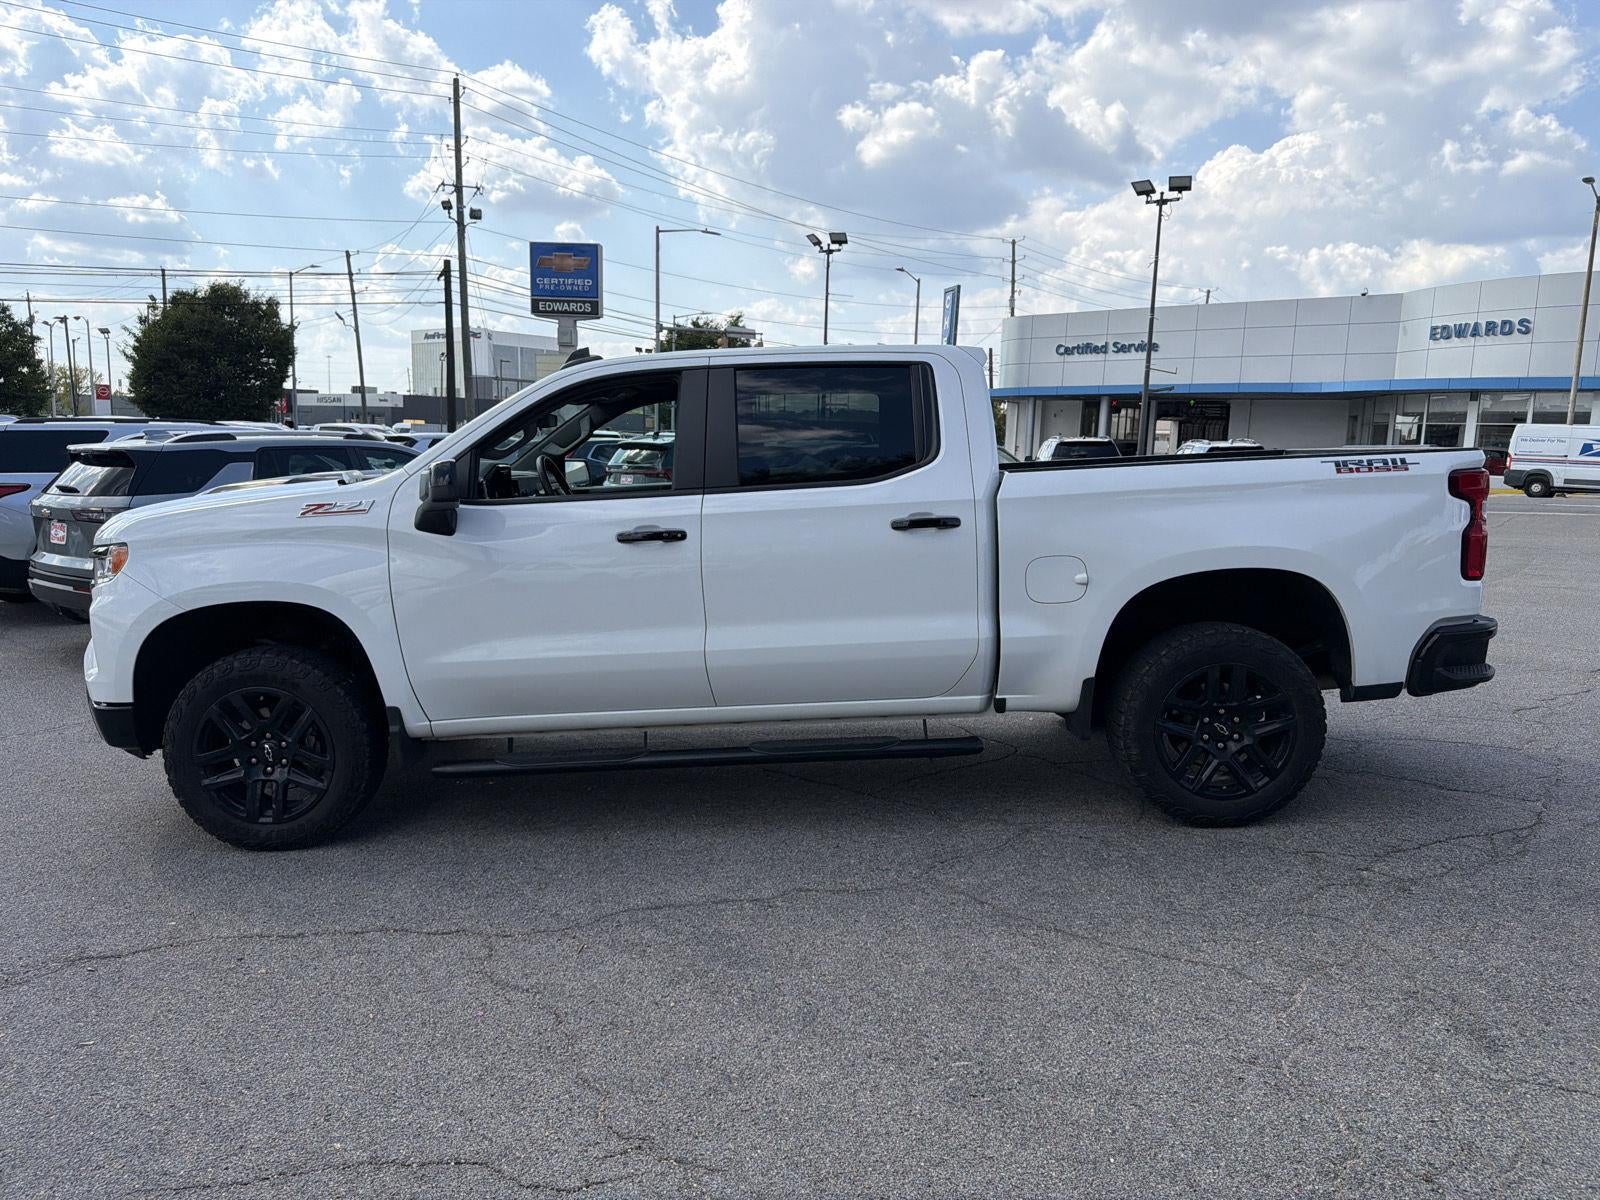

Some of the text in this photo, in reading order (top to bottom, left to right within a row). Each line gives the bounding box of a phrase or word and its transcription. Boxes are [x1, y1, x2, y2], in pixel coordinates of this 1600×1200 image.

[536, 277, 592, 286] CERTIFIED
[539, 284, 590, 292] PRE-OWNED
[538, 301, 592, 312] EDWARDS
[1429, 317, 1533, 341] EDWARDS
[1055, 341, 1108, 356] Certified
[316, 396, 342, 404] NISSAN
[1320, 457, 1420, 468] TRAIL
[297, 500, 375, 518] Z71
